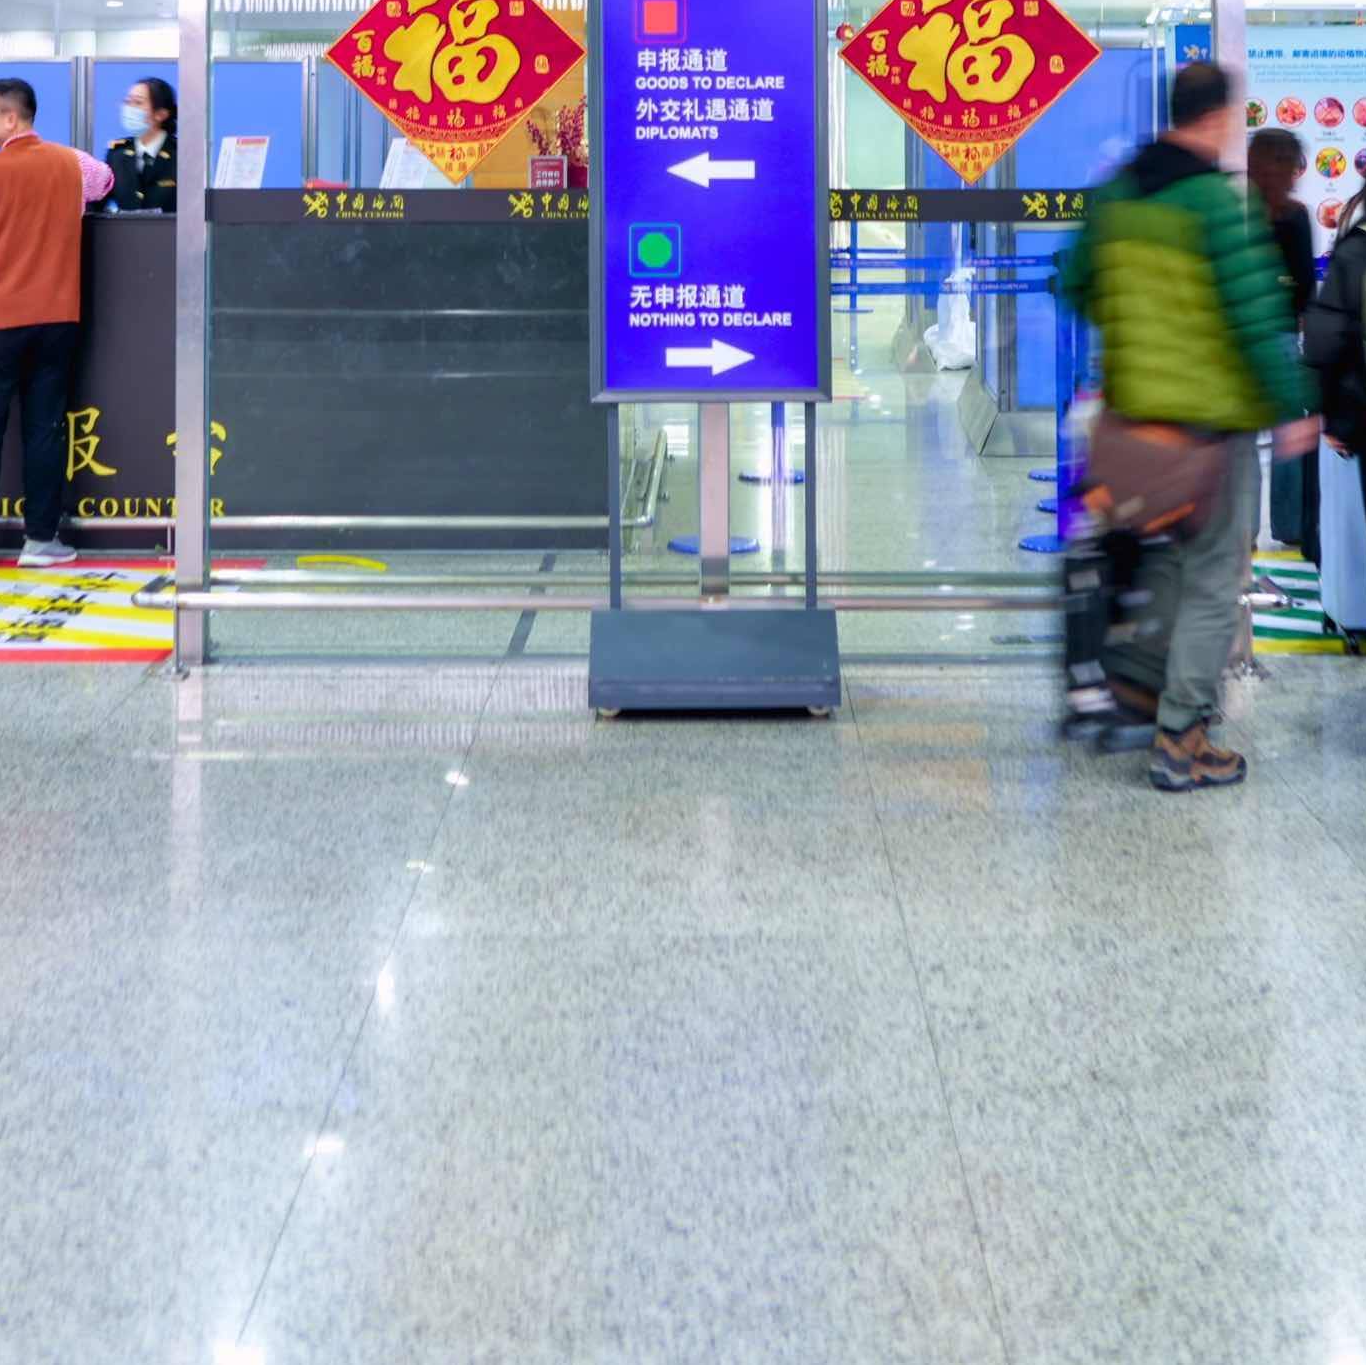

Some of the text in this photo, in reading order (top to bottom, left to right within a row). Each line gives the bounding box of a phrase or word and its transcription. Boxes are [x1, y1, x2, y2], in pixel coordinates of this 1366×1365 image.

[352, 29, 376, 78] 百福
[637, 48, 728, 73] 申报通道
[867, 29, 890, 78] 百福
[636, 76, 786, 90] GOODS TO DECLARE
[636, 97, 775, 123] 外交礼遇通道
[636, 126, 720, 140] DIPLOMATS
[629, 283, 746, 310] 无申报通道
[629, 312, 792, 327] NOTHING TO DECLARE
[77, 496, 226, 517] COUNTR
